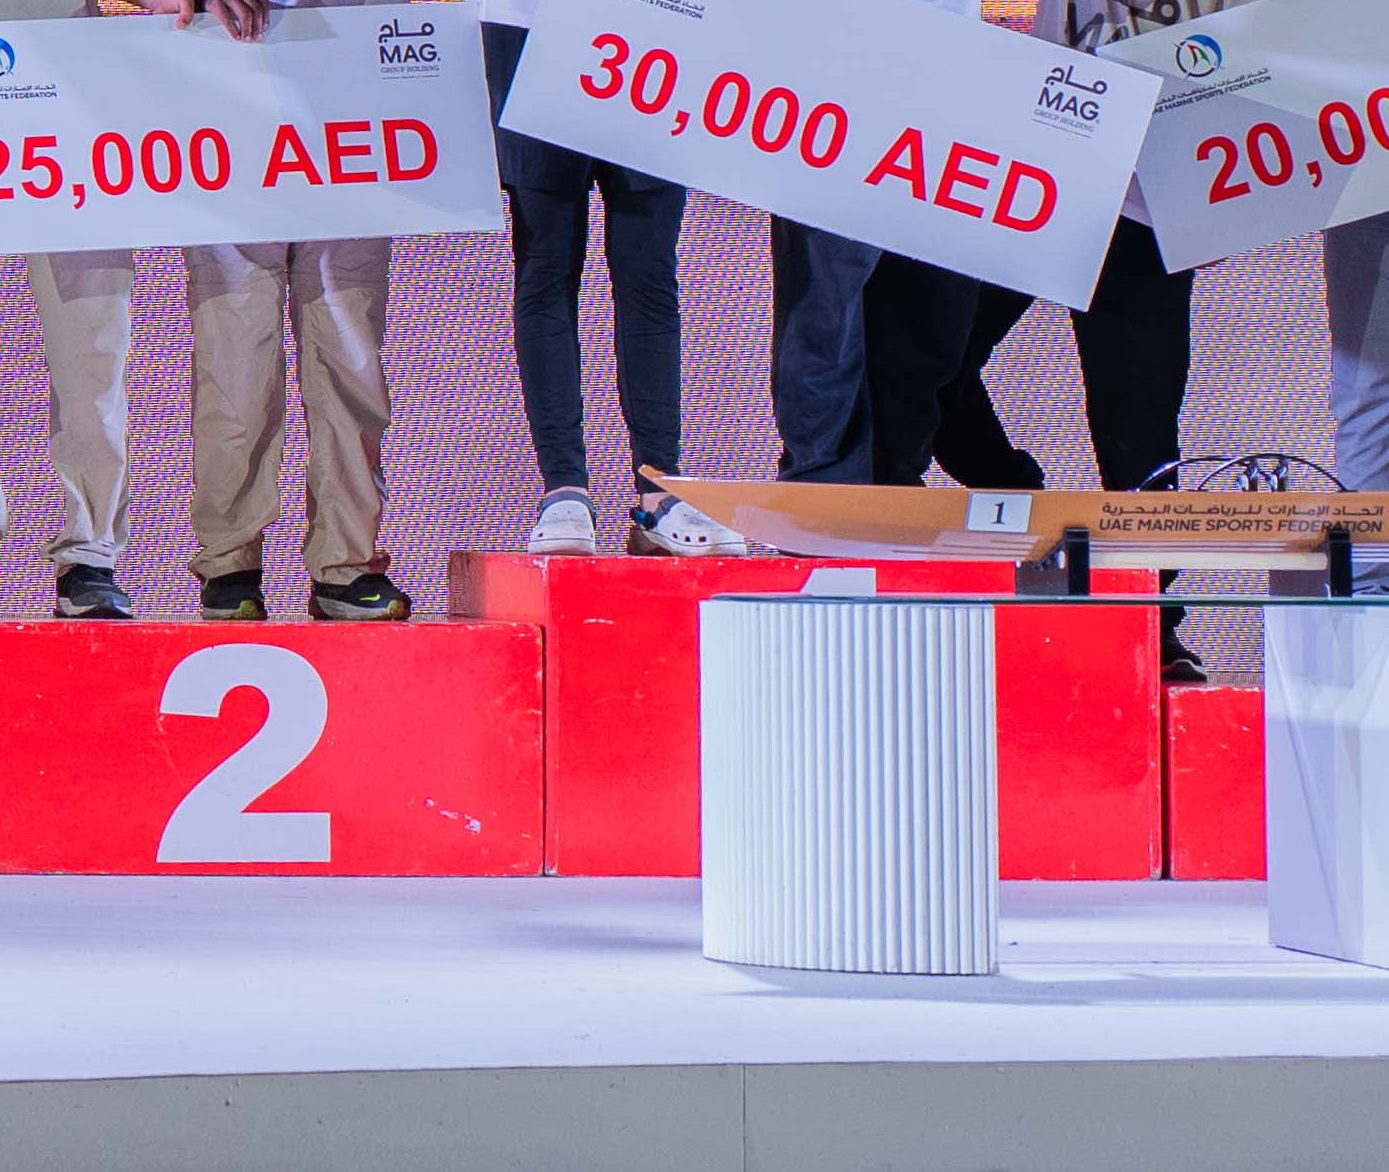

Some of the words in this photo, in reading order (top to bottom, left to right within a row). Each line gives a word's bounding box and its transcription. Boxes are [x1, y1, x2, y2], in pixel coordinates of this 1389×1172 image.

[656, 0, 702, 19] FEDERATION
[379, 43, 438, 63] MAG
[1225, 75, 1271, 93] FEDERATION
[10, 91, 57, 99] FEDERATION
[1038, 86, 1100, 121] MAG
[579, 33, 849, 169] 30,000
[864, 128, 1059, 233] AED
[262, 118, 439, 188] AED
[991, 501, 1005, 524] 1
[1099, 519, 1134, 531] UAE
[1137, 519, 1202, 531] MARINE
[1205, 519, 1273, 532] SPORTS
[1277, 519, 1383, 533] FEDERATION
[156, 642, 331, 864] 2
